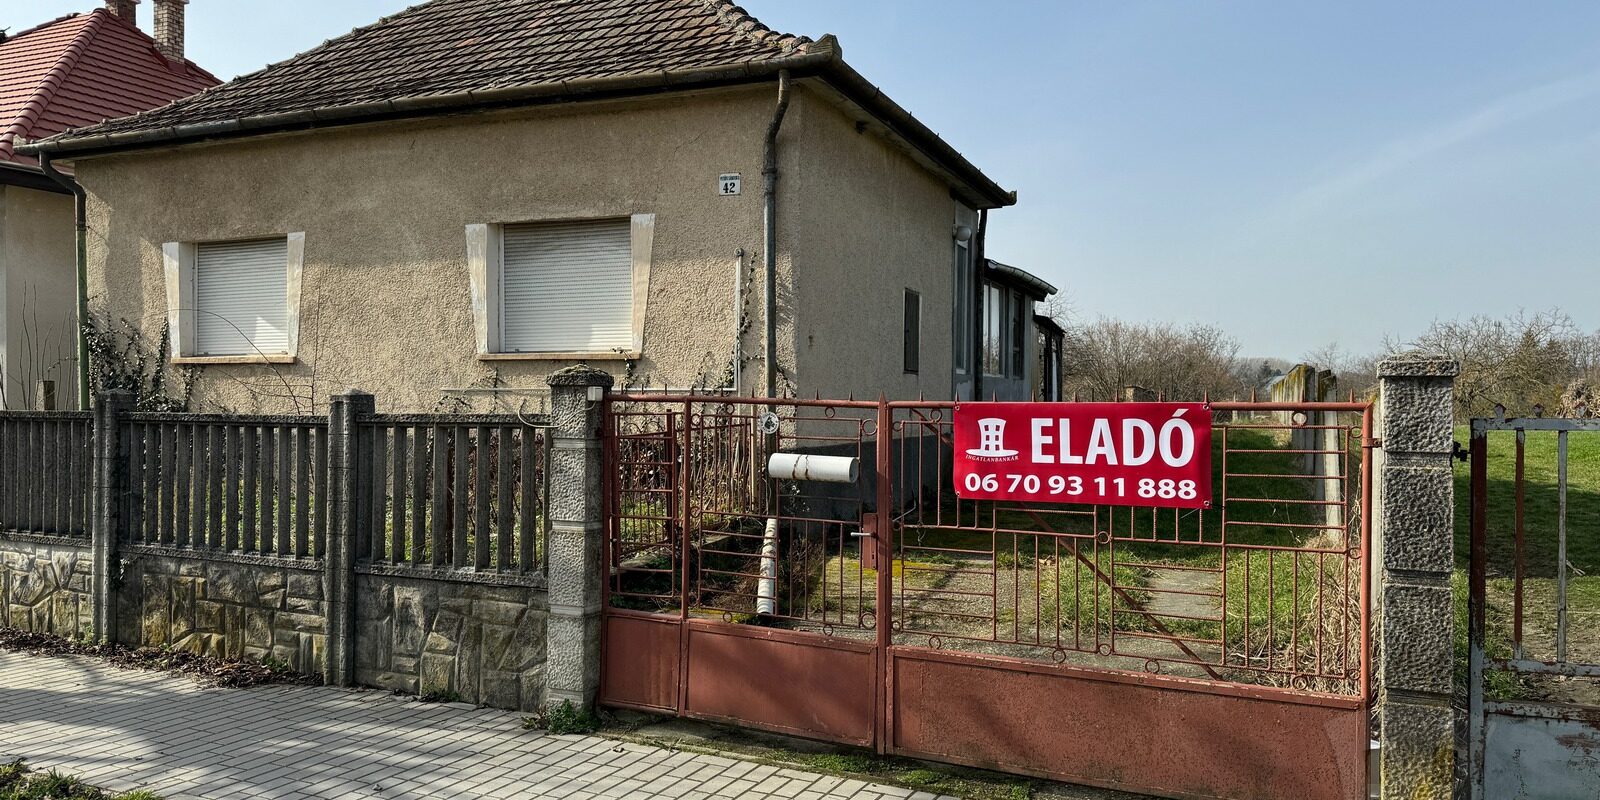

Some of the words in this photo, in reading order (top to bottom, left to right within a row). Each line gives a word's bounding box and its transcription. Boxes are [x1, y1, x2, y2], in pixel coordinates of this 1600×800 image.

[723, 182, 735, 193] 42
[1030, 408, 1195, 467] ELADÓ
[964, 472, 999, 492] 06
[1006, 474, 1041, 494] 70
[1047, 475, 1084, 496] 93
[1094, 476, 1125, 497] 11
[1137, 478, 1197, 500] 888
